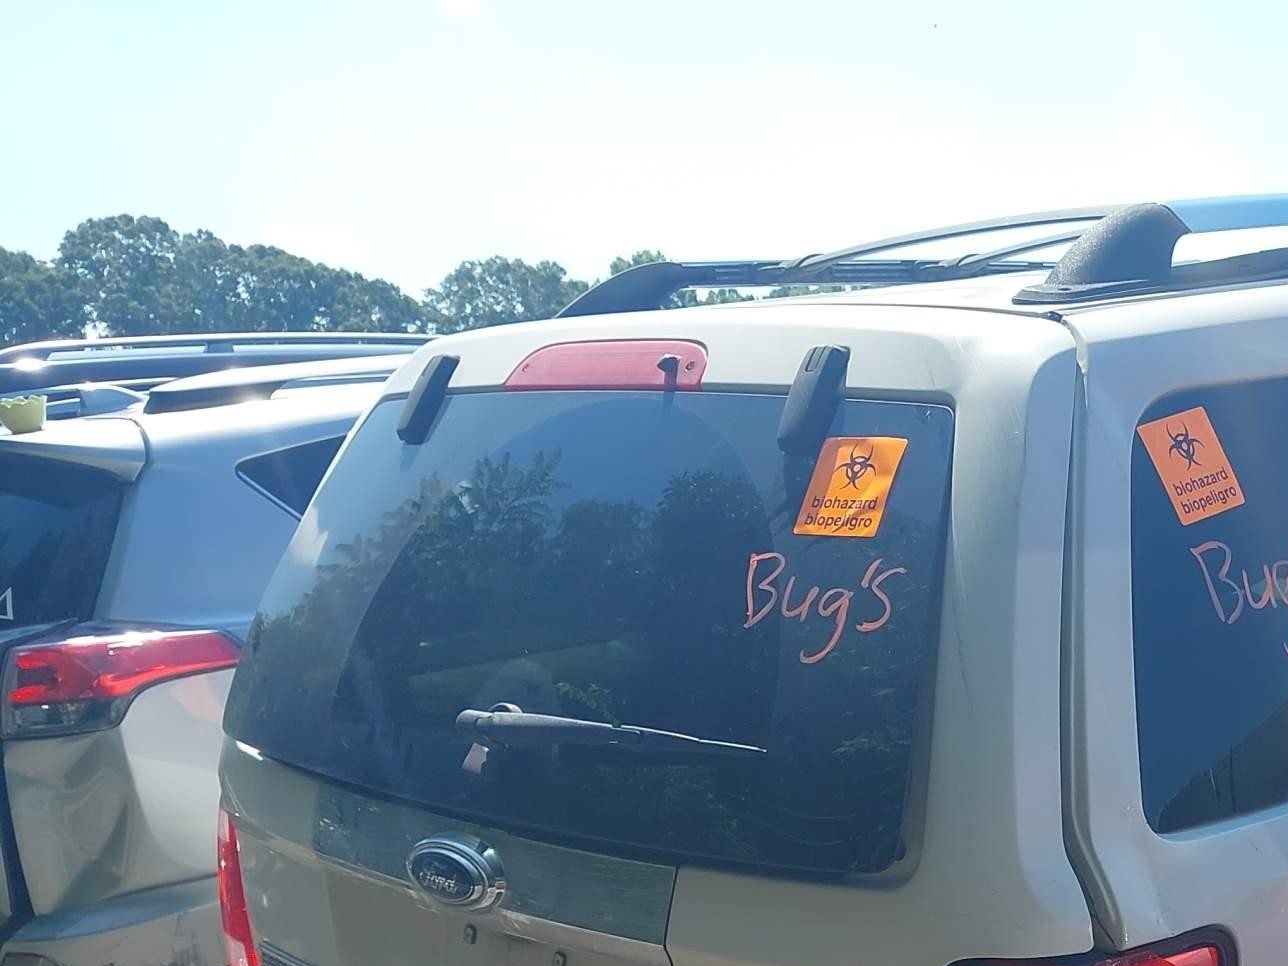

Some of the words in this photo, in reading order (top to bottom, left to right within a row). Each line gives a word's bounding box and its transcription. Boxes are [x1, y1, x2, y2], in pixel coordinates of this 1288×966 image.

[1173, 466, 1229, 496] biohazard
[811, 495, 879, 511] biohazard
[1181, 485, 1237, 514] biopeligro
[804, 512, 873, 530] biopeligro
[744, 552, 907, 664] Bug's
